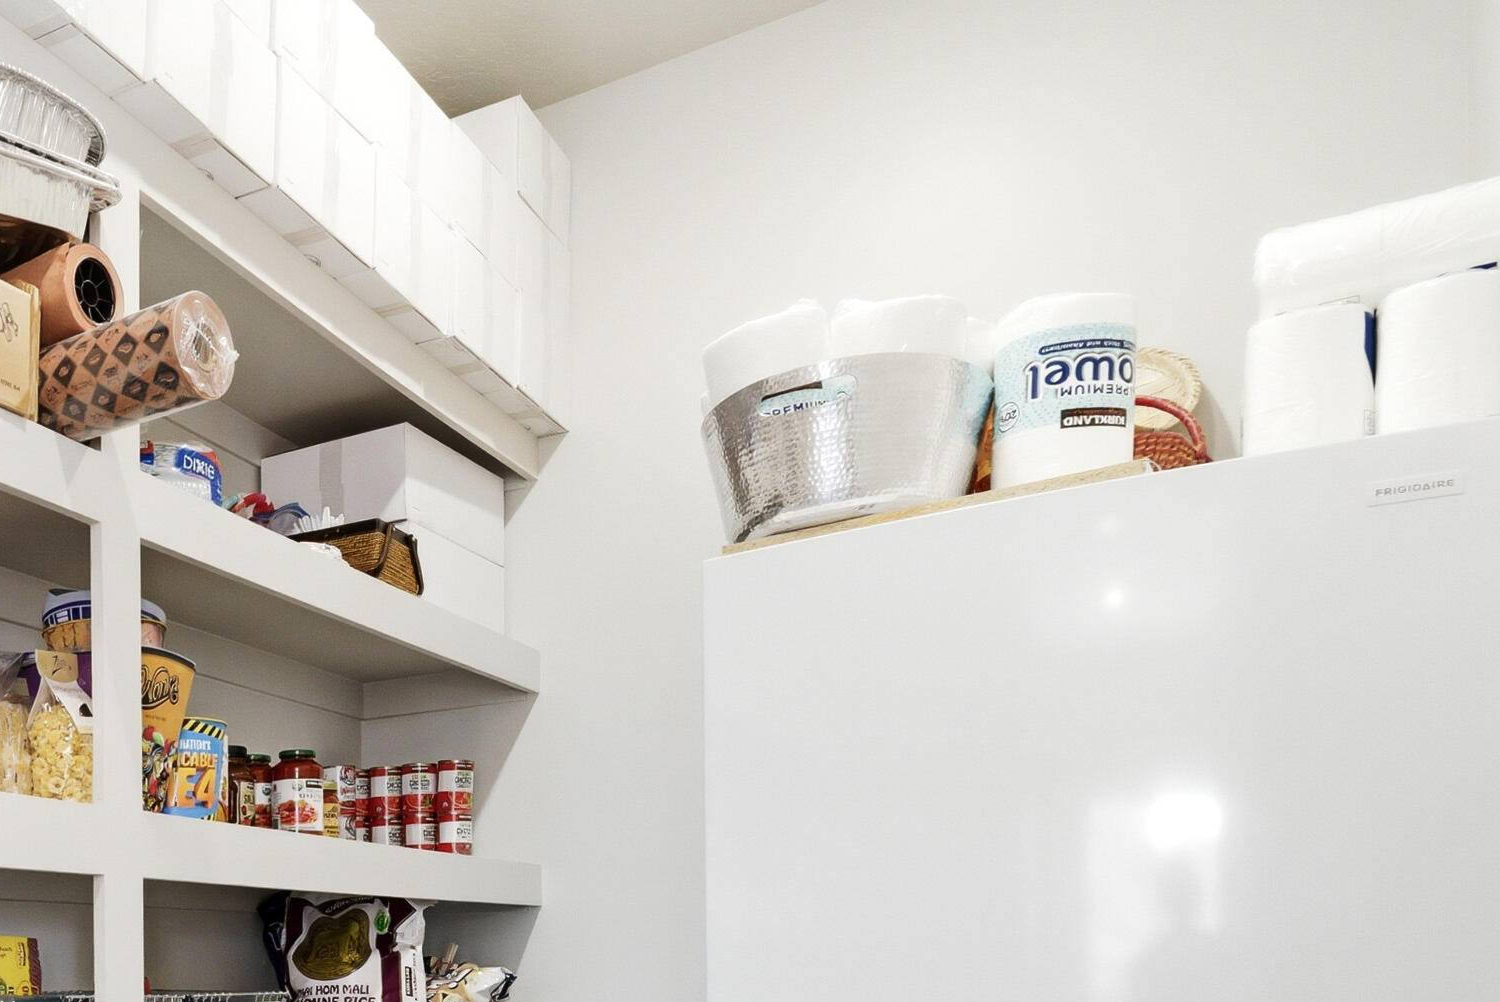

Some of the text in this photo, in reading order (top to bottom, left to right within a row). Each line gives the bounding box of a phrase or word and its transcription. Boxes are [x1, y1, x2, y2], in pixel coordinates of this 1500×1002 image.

[1062, 411, 1126, 429] KIRKLAND
[183, 454, 215, 481] DIXIE
[1375, 479, 1455, 497] FRIGIDAIRE
[315, 984, 370, 996] HOM MALI
